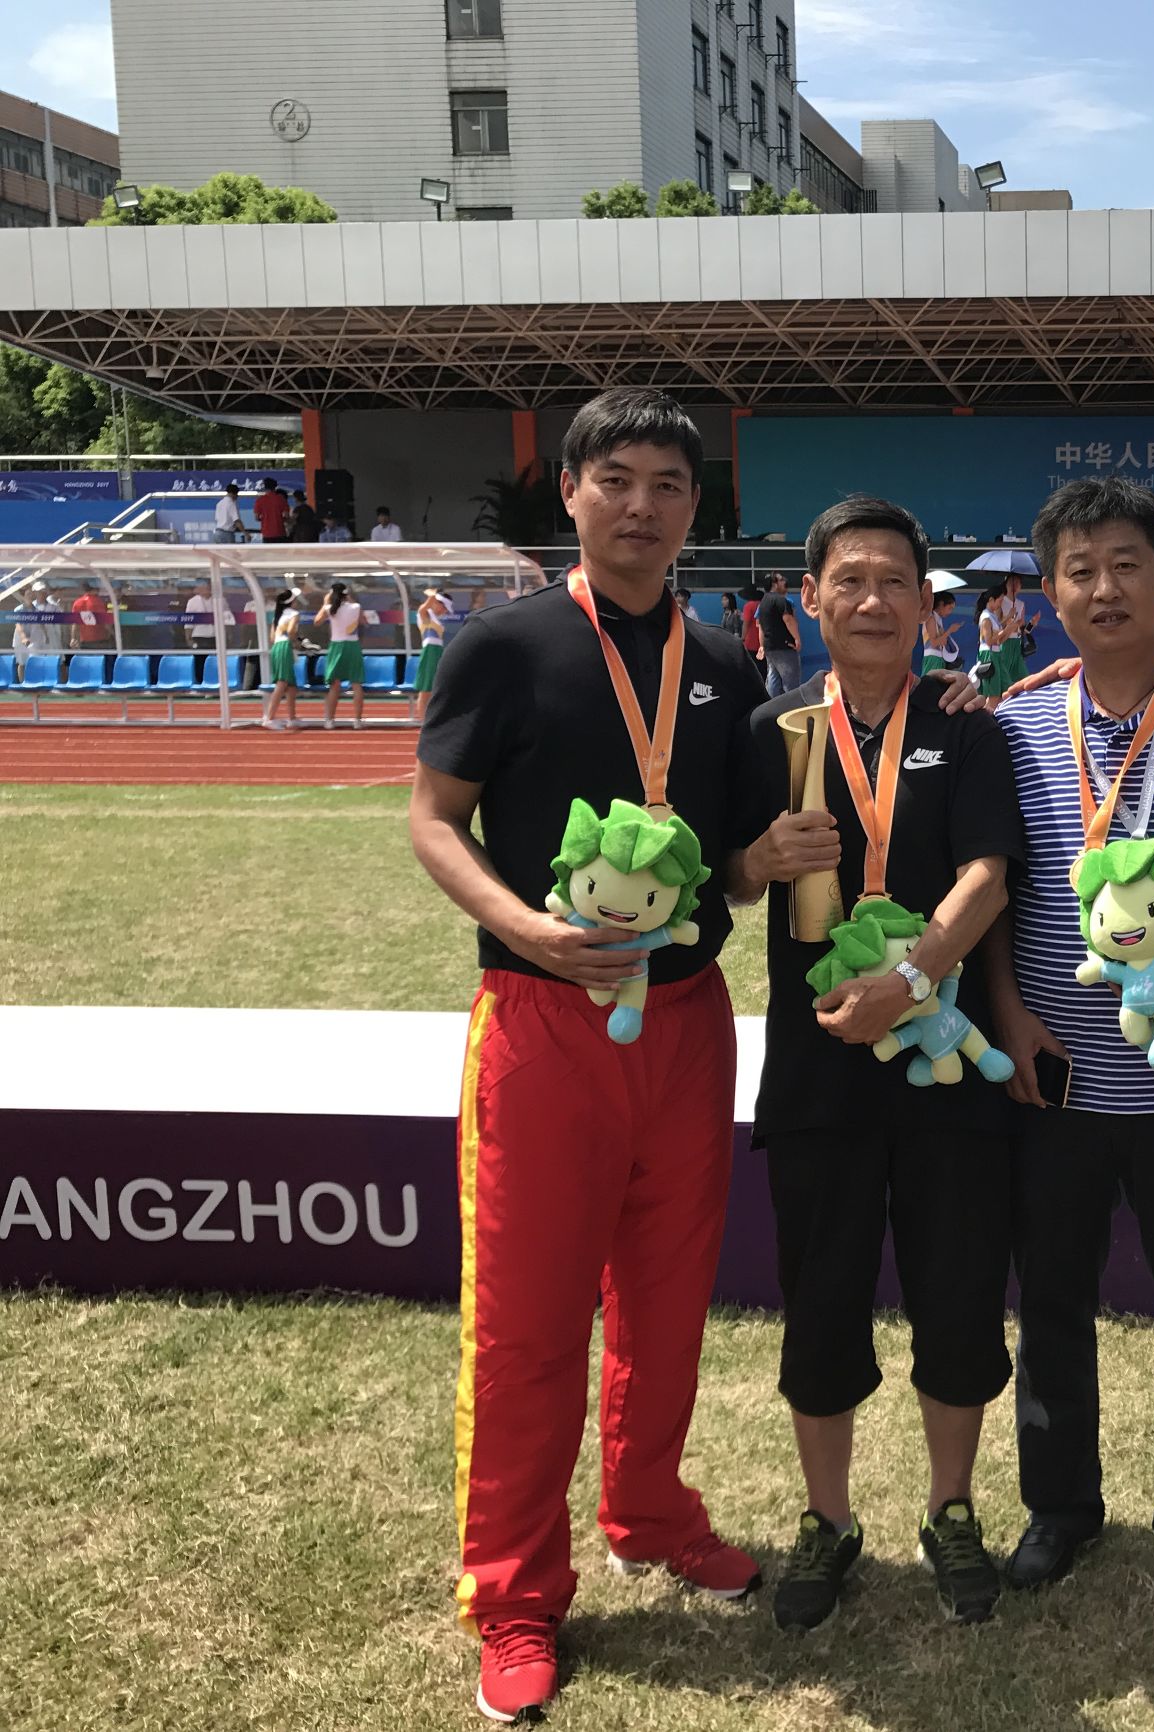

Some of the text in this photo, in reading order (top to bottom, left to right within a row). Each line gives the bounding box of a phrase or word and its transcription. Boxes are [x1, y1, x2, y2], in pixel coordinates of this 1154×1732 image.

[693, 681, 713, 698] NIKE
[911, 747, 944, 763] NIKE
[0, 1176, 418, 1247] ANGZHOU
